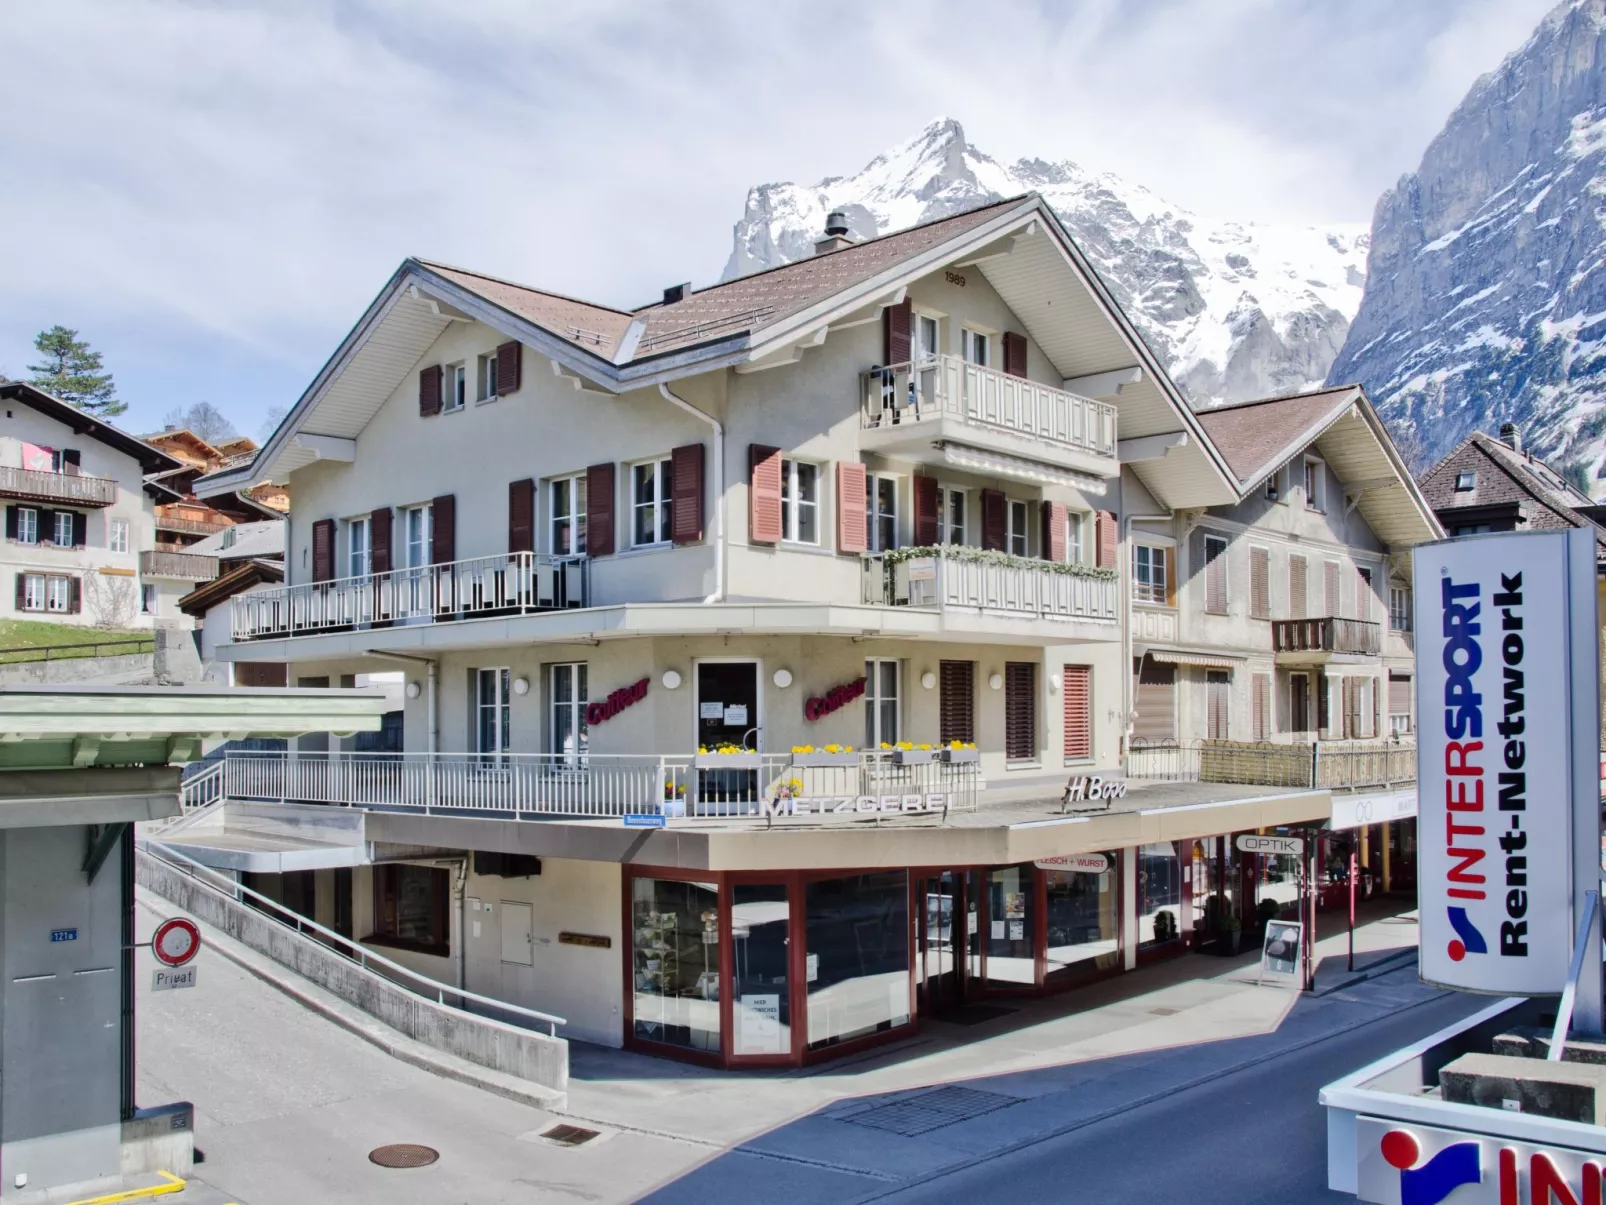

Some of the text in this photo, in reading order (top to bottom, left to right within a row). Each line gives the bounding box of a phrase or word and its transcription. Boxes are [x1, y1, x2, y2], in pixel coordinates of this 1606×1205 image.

[945, 271, 966, 287] 1989
[1441, 576, 1487, 900] INTERSPORT
[1493, 570, 1528, 957] Rent-Network
[758, 793, 953, 817] METZGEREI
[1245, 837, 1296, 851] OPTIK
[1076, 858, 1105, 868] WURST
[156, 971, 193, 986] Privat
